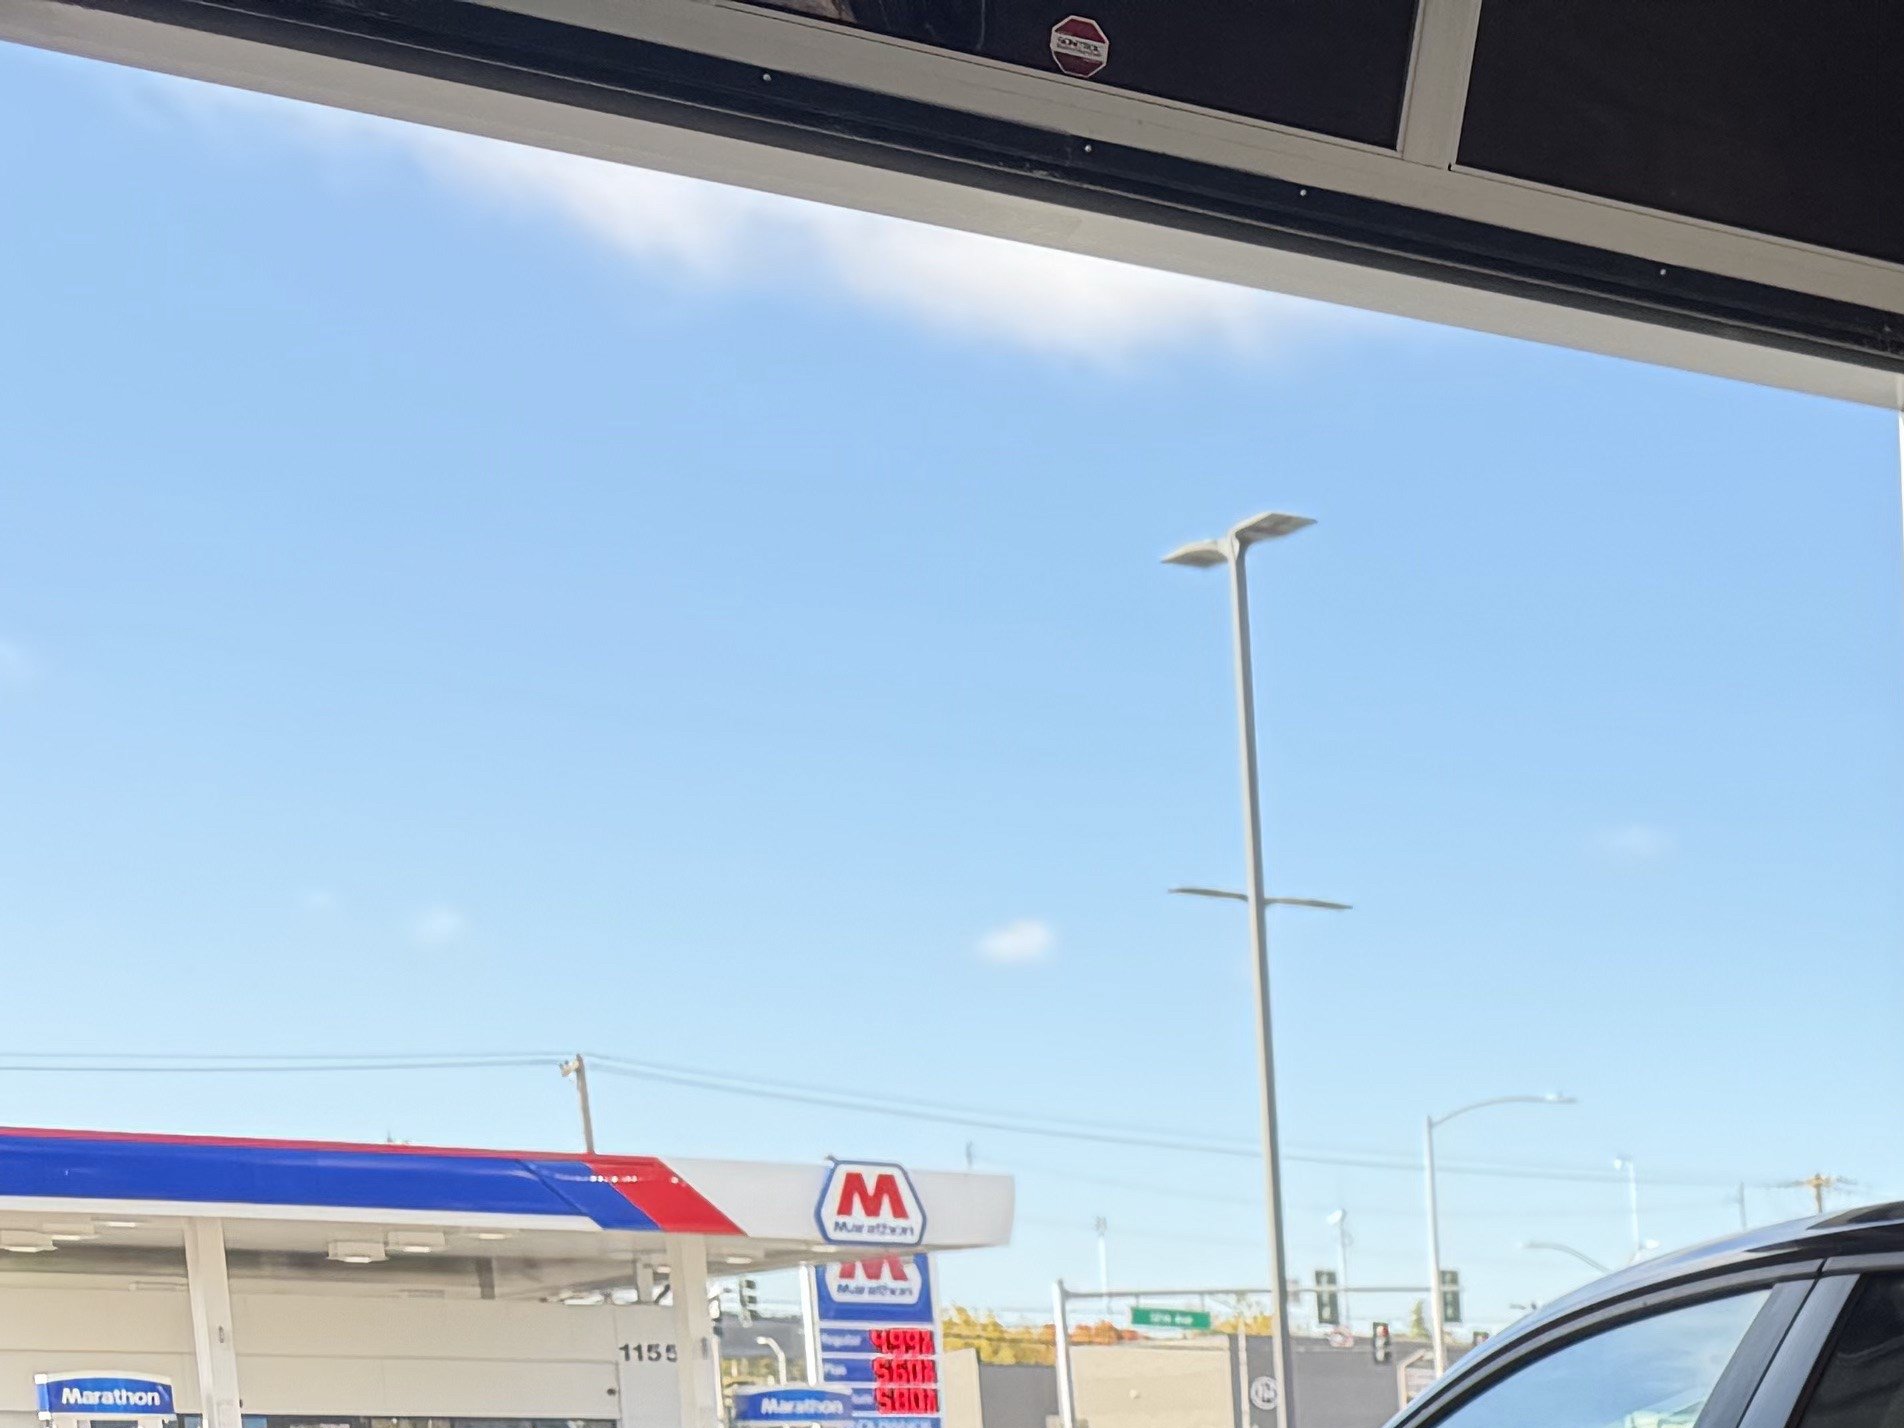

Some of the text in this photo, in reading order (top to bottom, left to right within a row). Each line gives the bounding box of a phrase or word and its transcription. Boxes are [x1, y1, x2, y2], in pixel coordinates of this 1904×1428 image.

[837, 1172, 909, 1218] M
[834, 1221, 914, 1236] Marathon
[619, 1343, 678, 1362] 1155
[61, 1387, 161, 1406] Marathon
